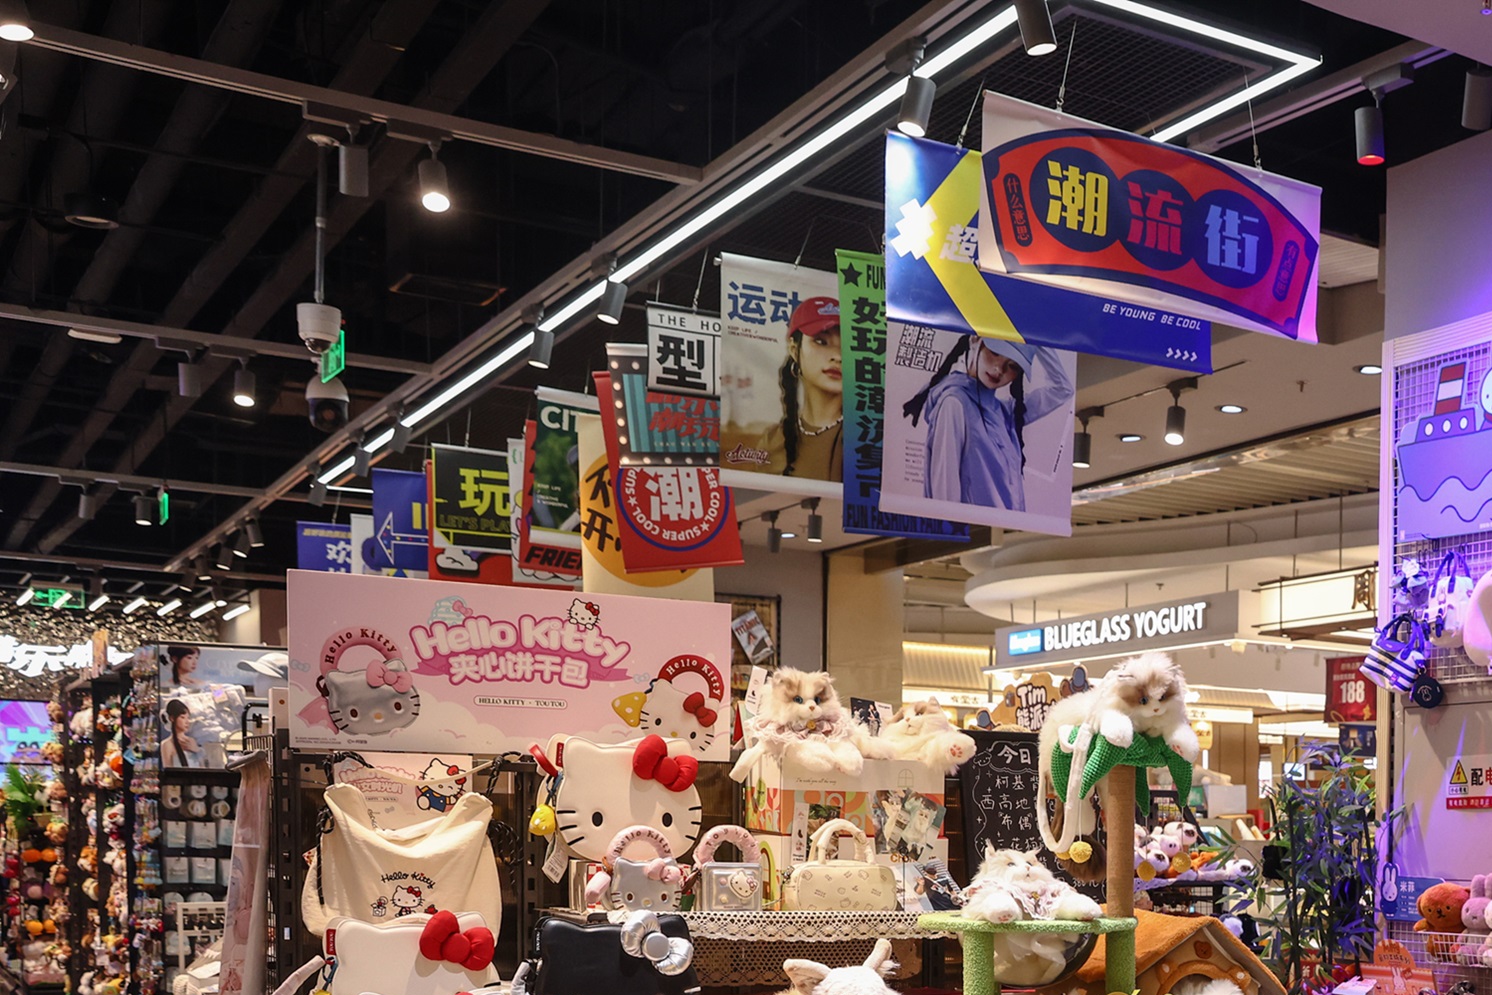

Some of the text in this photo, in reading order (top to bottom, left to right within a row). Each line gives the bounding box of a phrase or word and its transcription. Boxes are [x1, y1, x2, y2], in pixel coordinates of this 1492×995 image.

[1006, 177, 1030, 241] 什么意思
[1046, 159, 1259, 275] 潮流街
[657, 313, 687, 328] THE
[1103, 303, 1201, 331] BE YOUNG BE COOL
[655, 334, 708, 391] 型
[459, 468, 510, 517] 玩
[643, 467, 705, 522] 潮
[409, 614, 632, 668] Hello Kitty
[1043, 614, 1131, 652] BLUEGLASS
[1133, 601, 1207, 639] YOGURT
[324, 627, 399, 665] Hello Kitty
[448, 650, 591, 689] 夹心饼干包
[665, 657, 723, 697] Hello Kitty
[478, 697, 502, 705] HELLO
[503, 698, 526, 706] KITTY
[1016, 683, 1047, 708] Tim
[1340, 680, 1365, 703] 188
[997, 744, 1032, 766] 今日
[646, 830, 672, 855] Kitty
[381, 871, 436, 889] Hello Kitty
